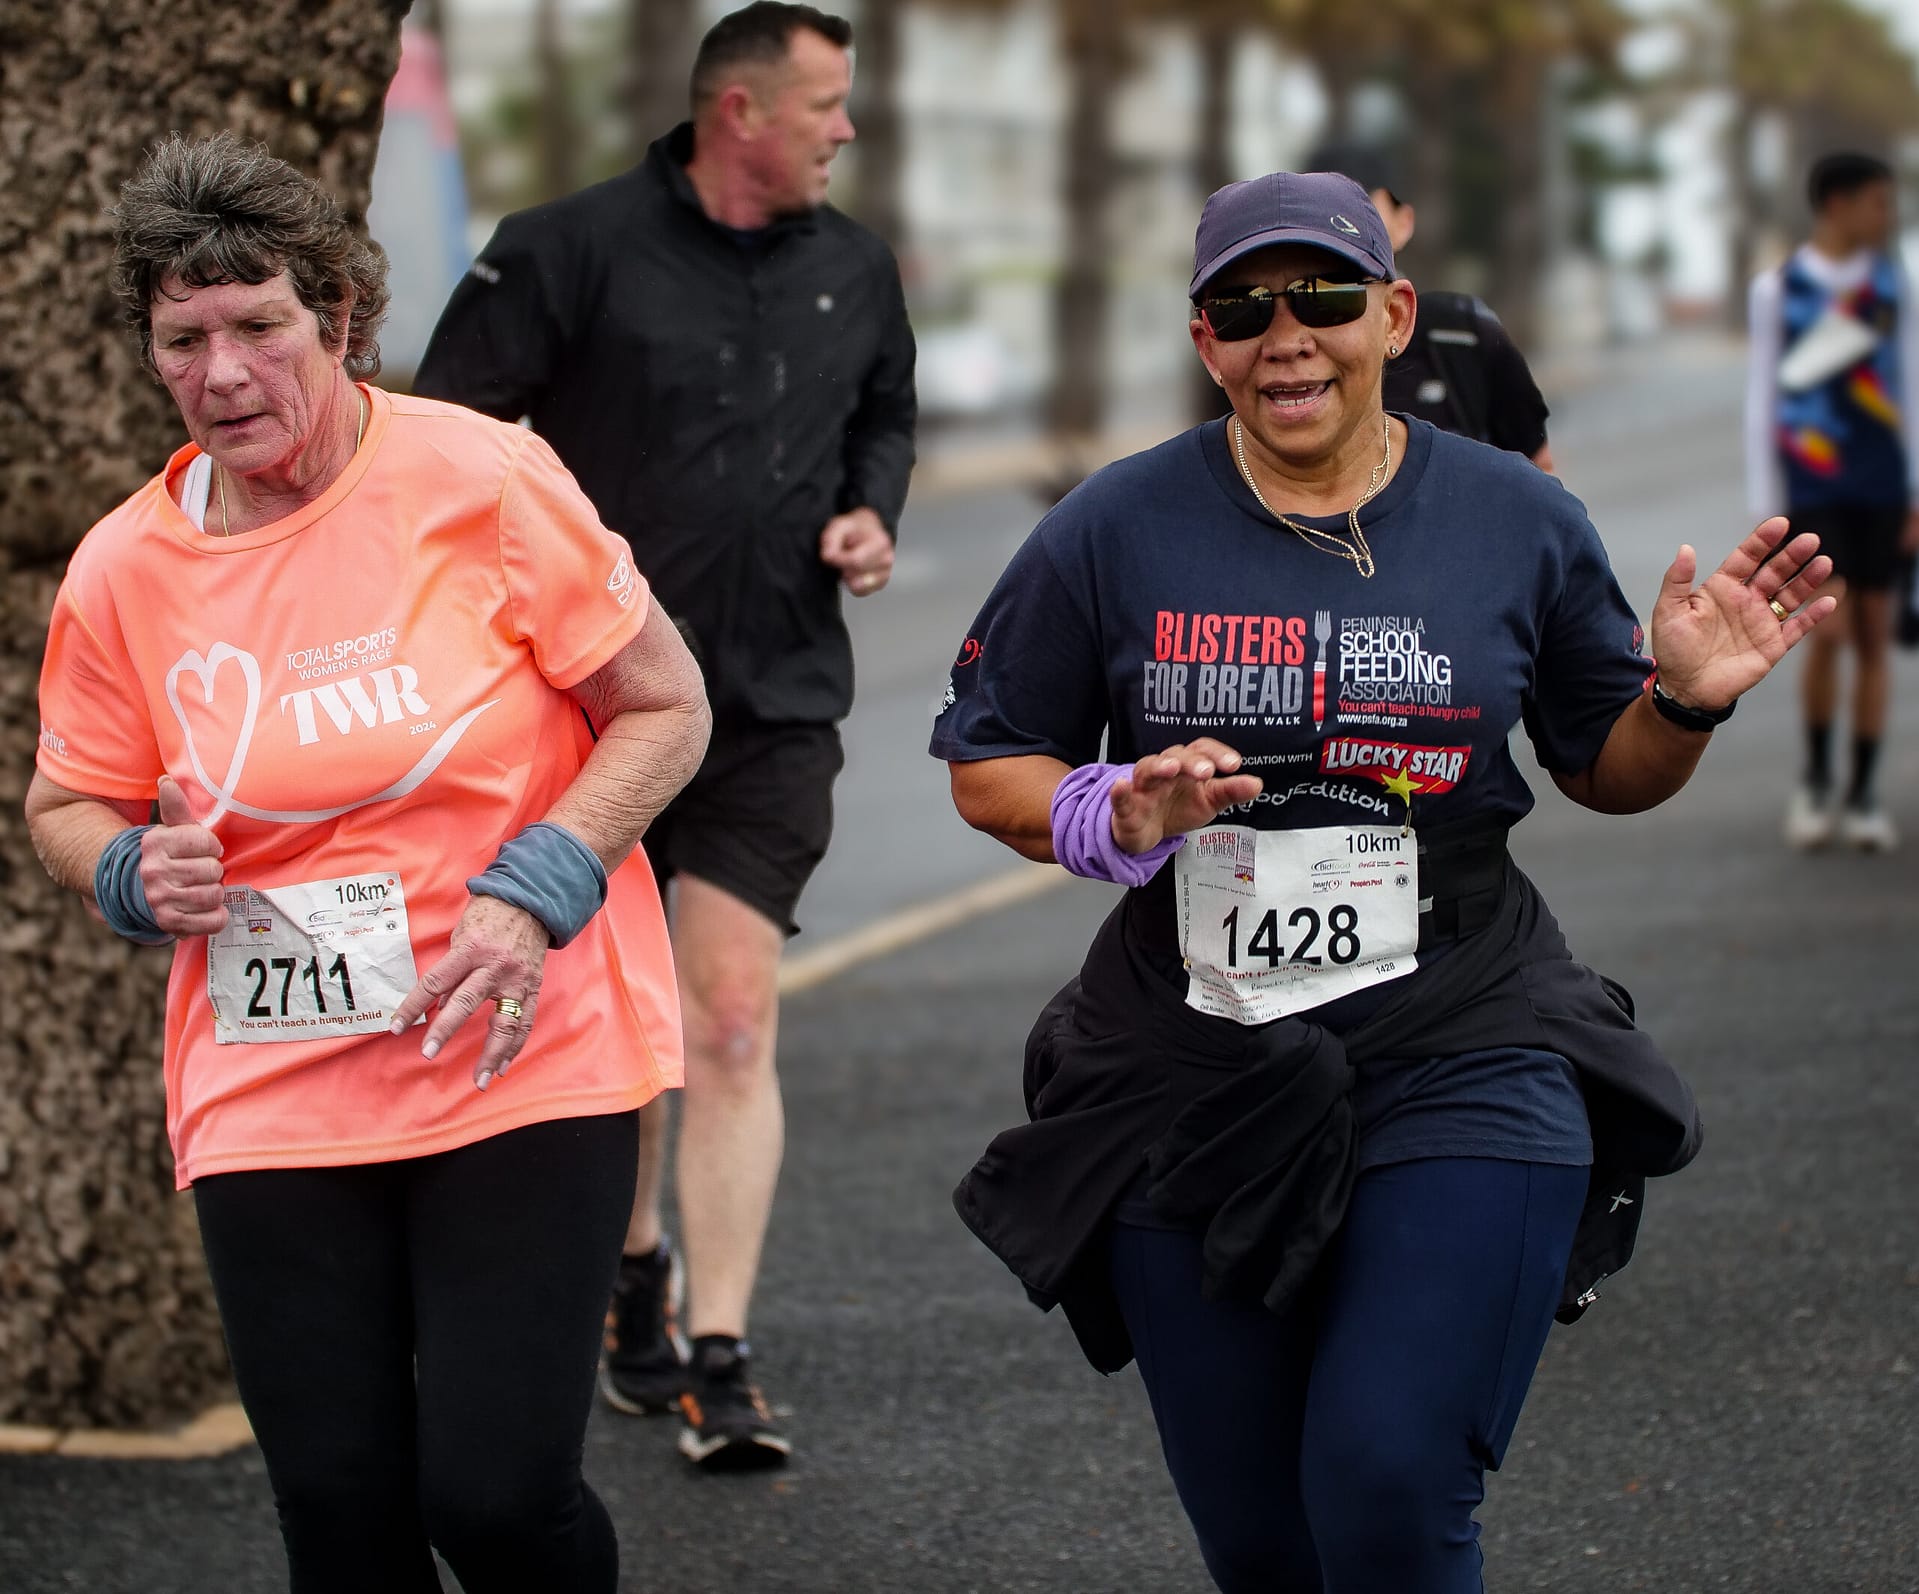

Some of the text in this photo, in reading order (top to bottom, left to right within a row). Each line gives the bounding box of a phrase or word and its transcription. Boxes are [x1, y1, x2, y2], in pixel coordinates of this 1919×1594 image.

[1341, 616, 1425, 634] PENINSULA
[286, 627, 397, 671] TOTALSPORTS
[1155, 610, 1306, 665] BLISTERS
[1339, 631, 1427, 655] SCHOOL
[299, 648, 392, 681] WOMEN'S RACE
[1339, 652, 1451, 685] FEEDING
[1143, 661, 1304, 714] FOR BREAD
[1339, 681, 1450, 705] ASSOCIATION
[280, 664, 431, 746] TWR
[1338, 699, 1359, 711] You
[1388, 702, 1418, 715] teach
[1419, 706, 1425, 714] a
[1426, 704, 1459, 721] hungry
[1461, 707, 1481, 719] child
[409, 720, 437, 736] 2024
[1145, 713, 1301, 726] CHARITY FAMILY FUN WALK
[1337, 713, 1408, 728] www.psfa.org.za
[1241, 752, 1313, 766] OCIATION WITH
[1326, 741, 1464, 783] LUCKY STAR
[1200, 832, 1236, 846] BLISTERS
[1346, 833, 1400, 854] 10km
[335, 882, 387, 904] 10km
[1223, 905, 1361, 968] 1428
[1376, 963, 1396, 975] 1428
[245, 952, 356, 1018] 2711
[240, 1009, 383, 1029] You can't teach a hungry child
